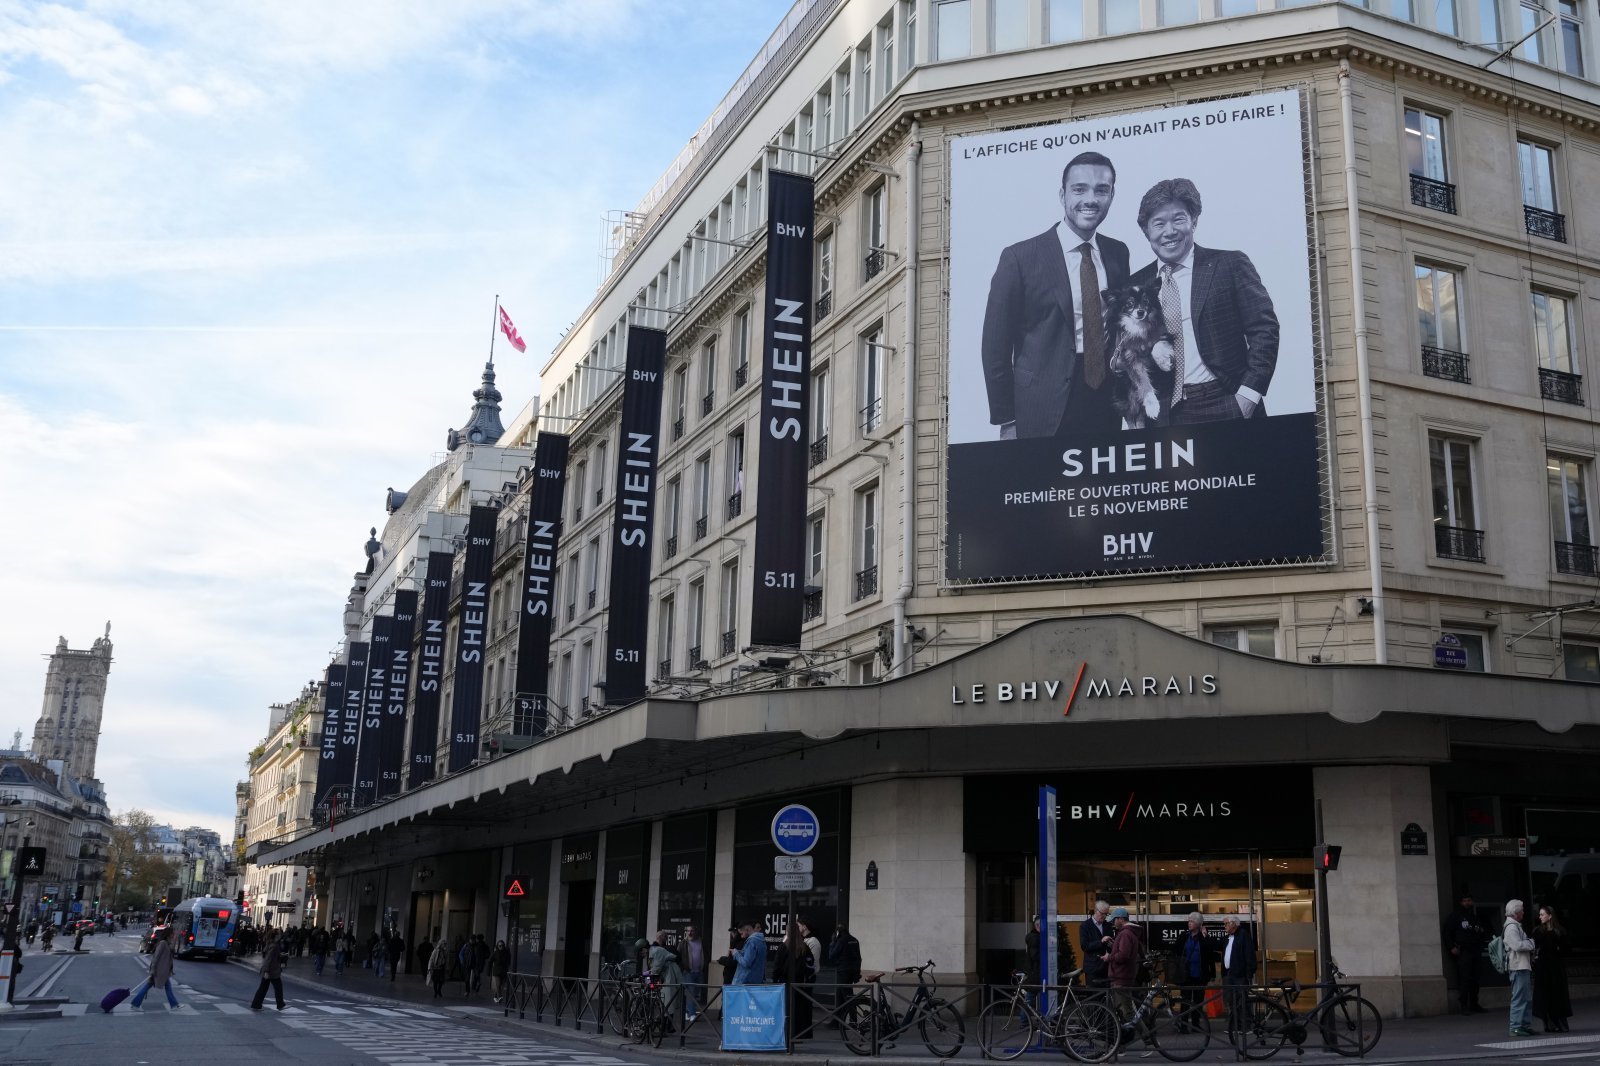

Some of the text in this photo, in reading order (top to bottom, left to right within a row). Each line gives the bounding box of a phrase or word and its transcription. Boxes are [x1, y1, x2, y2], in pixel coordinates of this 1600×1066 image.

[964, 139, 1038, 159] L'AFFICHE
[1042, 132, 1091, 149] QU'ON
[1096, 120, 1167, 142] N'AURAIT
[1172, 116, 1201, 130] PAS
[1206, 110, 1227, 126] DÛ
[1232, 105, 1275, 121] FAIRE
[776, 221, 806, 239] BHV
[632, 369, 658, 383] BHV
[769, 297, 805, 443] SHEIN
[1061, 438, 1195, 477] SHEIN
[539, 467, 561, 480] BHV
[620, 431, 653, 548] SHEIN
[1004, 473, 1256, 505] PREMIÈRE OUVERTURE MONDIALE
[1069, 497, 1189, 518] LE 5 NOVEMBRE
[472, 536, 491, 546] BHV
[1103, 531, 1154, 556] BHV
[526, 520, 554, 616] SHEIN
[430, 579, 448, 588] BHV
[764, 570, 796, 590] 5.11
[397, 613, 413, 622] BHV
[461, 581, 487, 664] SHEIN
[374, 635, 390, 643] BHV
[351, 659, 365, 667] BHV
[420, 619, 444, 692] SHEIN
[614, 648, 639, 663] 5.11
[388, 650, 409, 715] SHEIN
[952, 684, 985, 704] LE
[998, 680, 1062, 701] BHV
[1086, 674, 1217, 699] MARAIS
[366, 668, 385, 729] SHEIN
[343, 690, 361, 745] SHEIN
[322, 708, 340, 760] SHEIN
[456, 733, 475, 744] 5.11
[415, 754, 432, 764] 5.11
[359, 780, 374, 788] 5.11
[383, 771, 398, 780] 5.11
[1071, 804, 1117, 819] BHV
[1136, 801, 1232, 818] MARAIS
[618, 869, 629, 884] BHV
[676, 863, 690, 880] BHV
[765, 914, 799, 934] SHE
